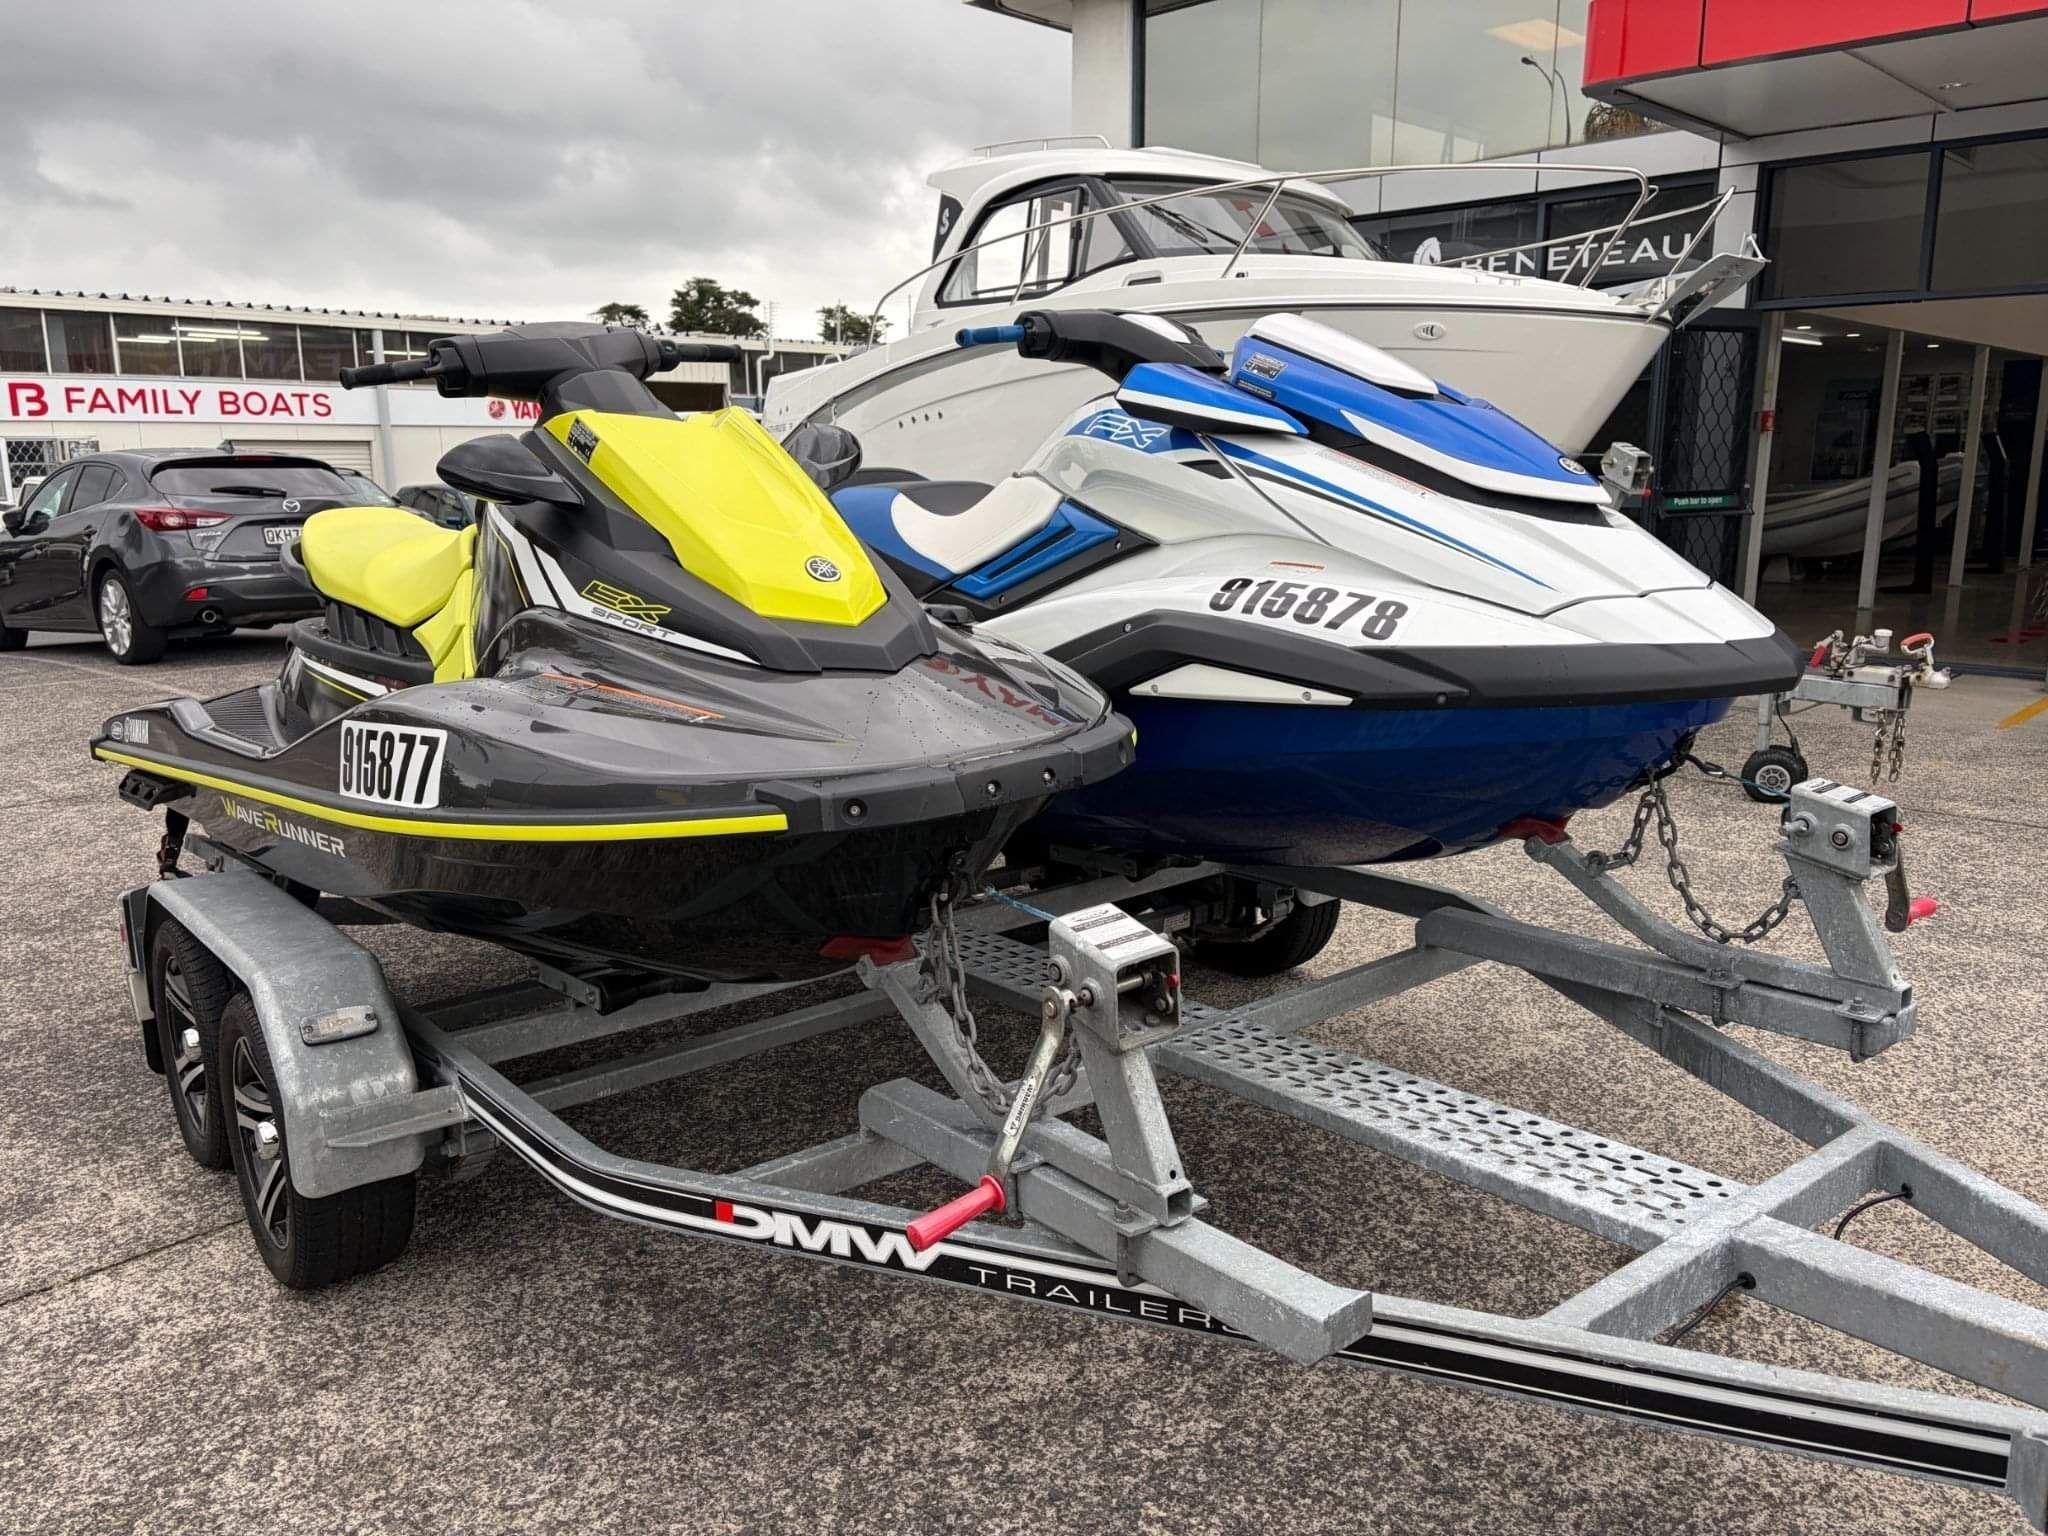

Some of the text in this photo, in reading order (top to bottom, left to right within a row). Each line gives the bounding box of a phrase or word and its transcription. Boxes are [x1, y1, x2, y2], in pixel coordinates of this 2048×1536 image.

[64, 387, 203, 415] FAMILY
[219, 390, 333, 418] BOATS
[1083, 413, 1168, 449] FX
[1673, 497, 1689, 506] Push
[1690, 497, 1700, 505] bar
[1708, 496, 1723, 506] open
[266, 529, 304, 542] QKH7
[581, 580, 672, 624] EX
[1208, 577, 1409, 641] 915878
[591, 606, 676, 638] SPORT
[342, 726, 441, 805] 915877
[715, 1200, 941, 1272] DMW
